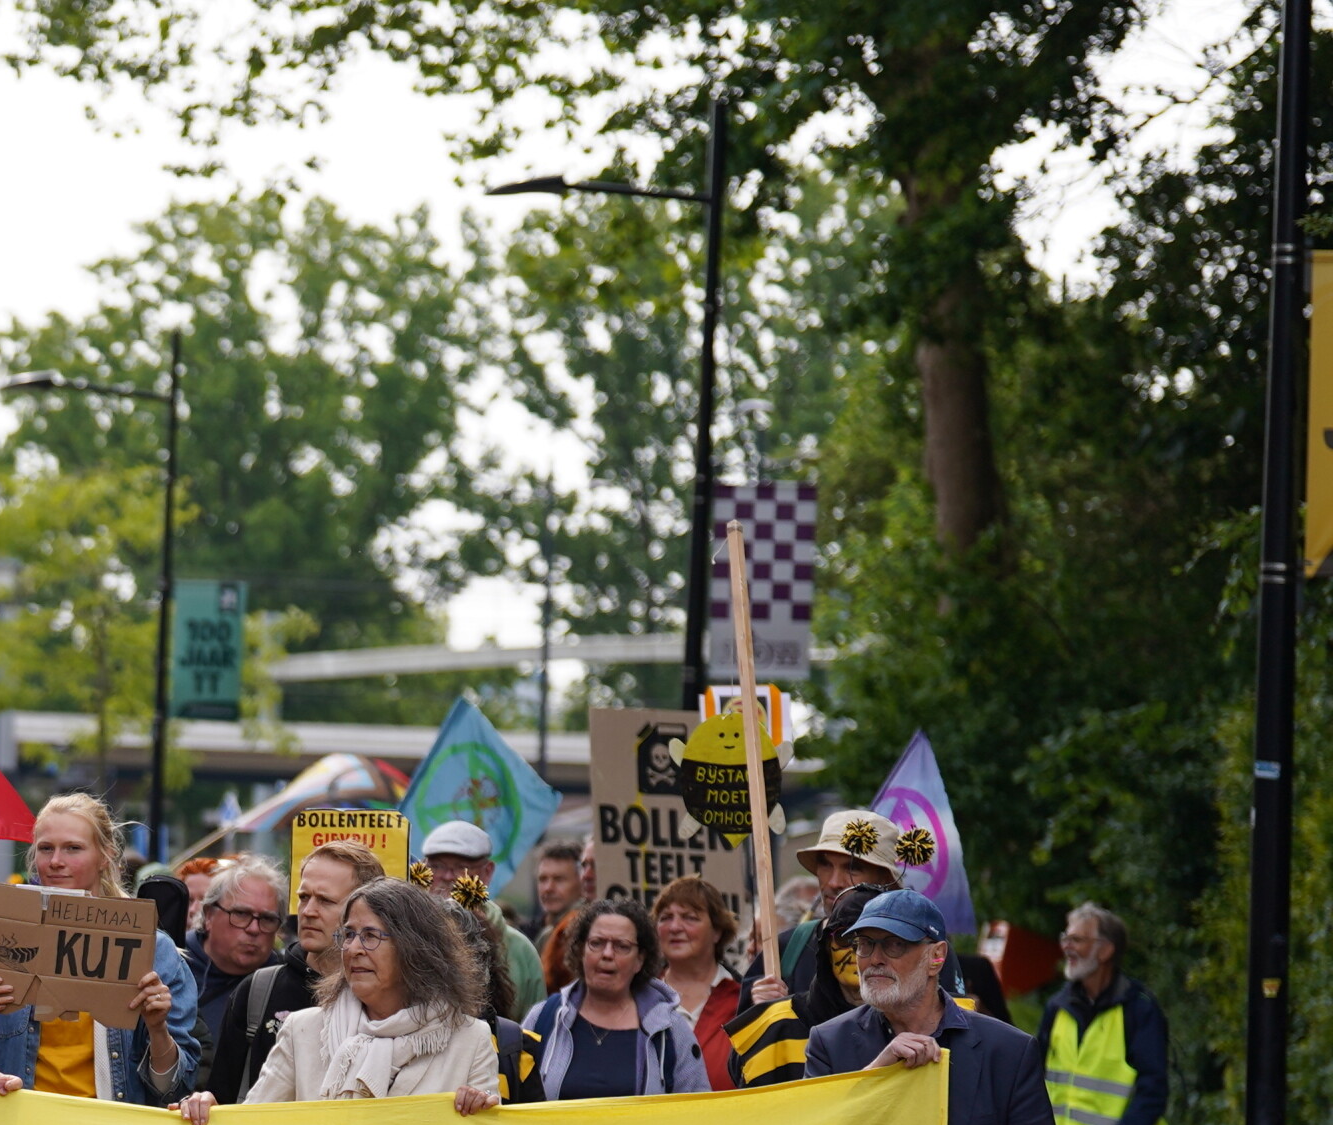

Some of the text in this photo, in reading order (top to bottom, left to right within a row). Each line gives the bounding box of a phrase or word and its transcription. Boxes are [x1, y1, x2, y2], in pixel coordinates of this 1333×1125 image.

[706, 788, 749, 804] MOET
[296, 812, 405, 829] BOLLENTEELT
[703, 808, 753, 826] OMHOO
[51, 900, 142, 929] HELEMAAL
[54, 929, 143, 981] KUT
